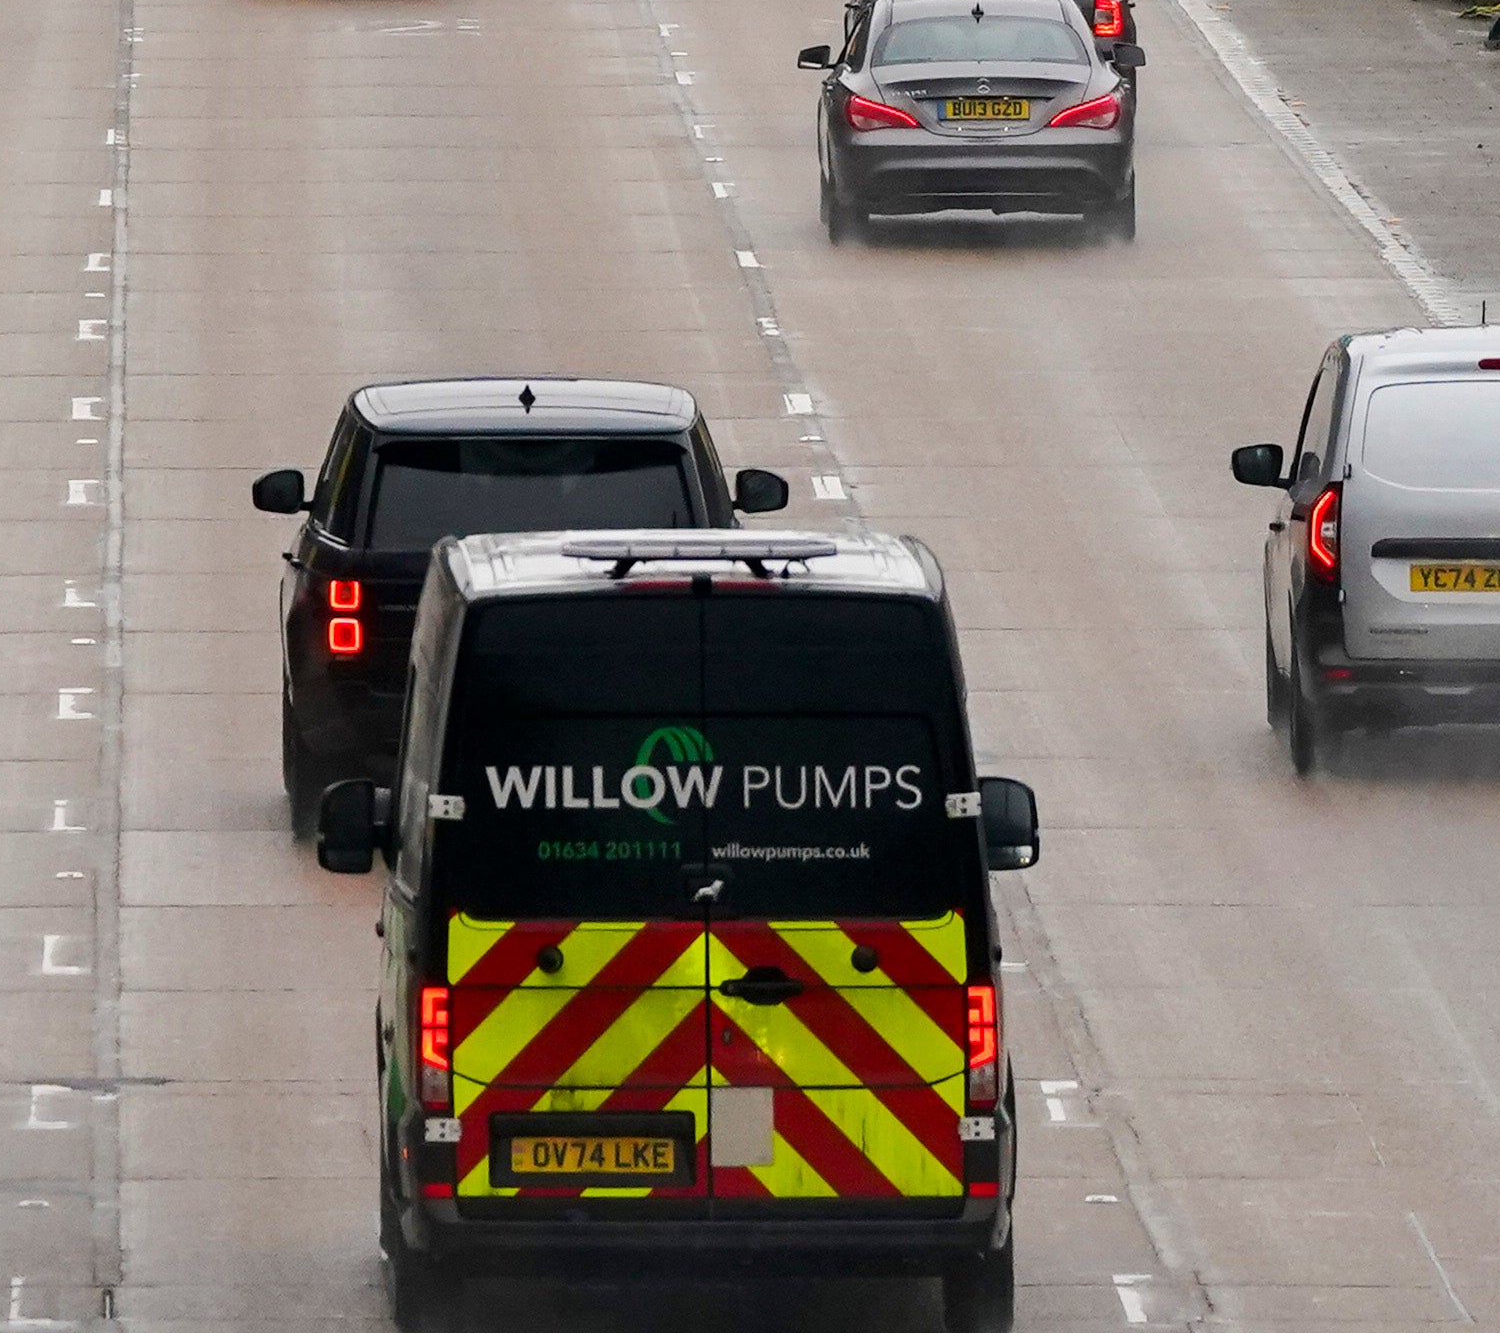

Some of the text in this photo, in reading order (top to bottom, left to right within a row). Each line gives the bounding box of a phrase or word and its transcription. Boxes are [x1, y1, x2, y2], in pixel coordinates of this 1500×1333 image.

[952, 99, 1024, 117] BU13 GZD
[1417, 567, 1477, 589] YE74
[484, 764, 924, 811] WILLOW PUMPS
[537, 840, 683, 861] 01634 201111
[711, 840, 871, 863] willowpumps.co.uk
[532, 1141, 670, 1170] OV74 LKE
